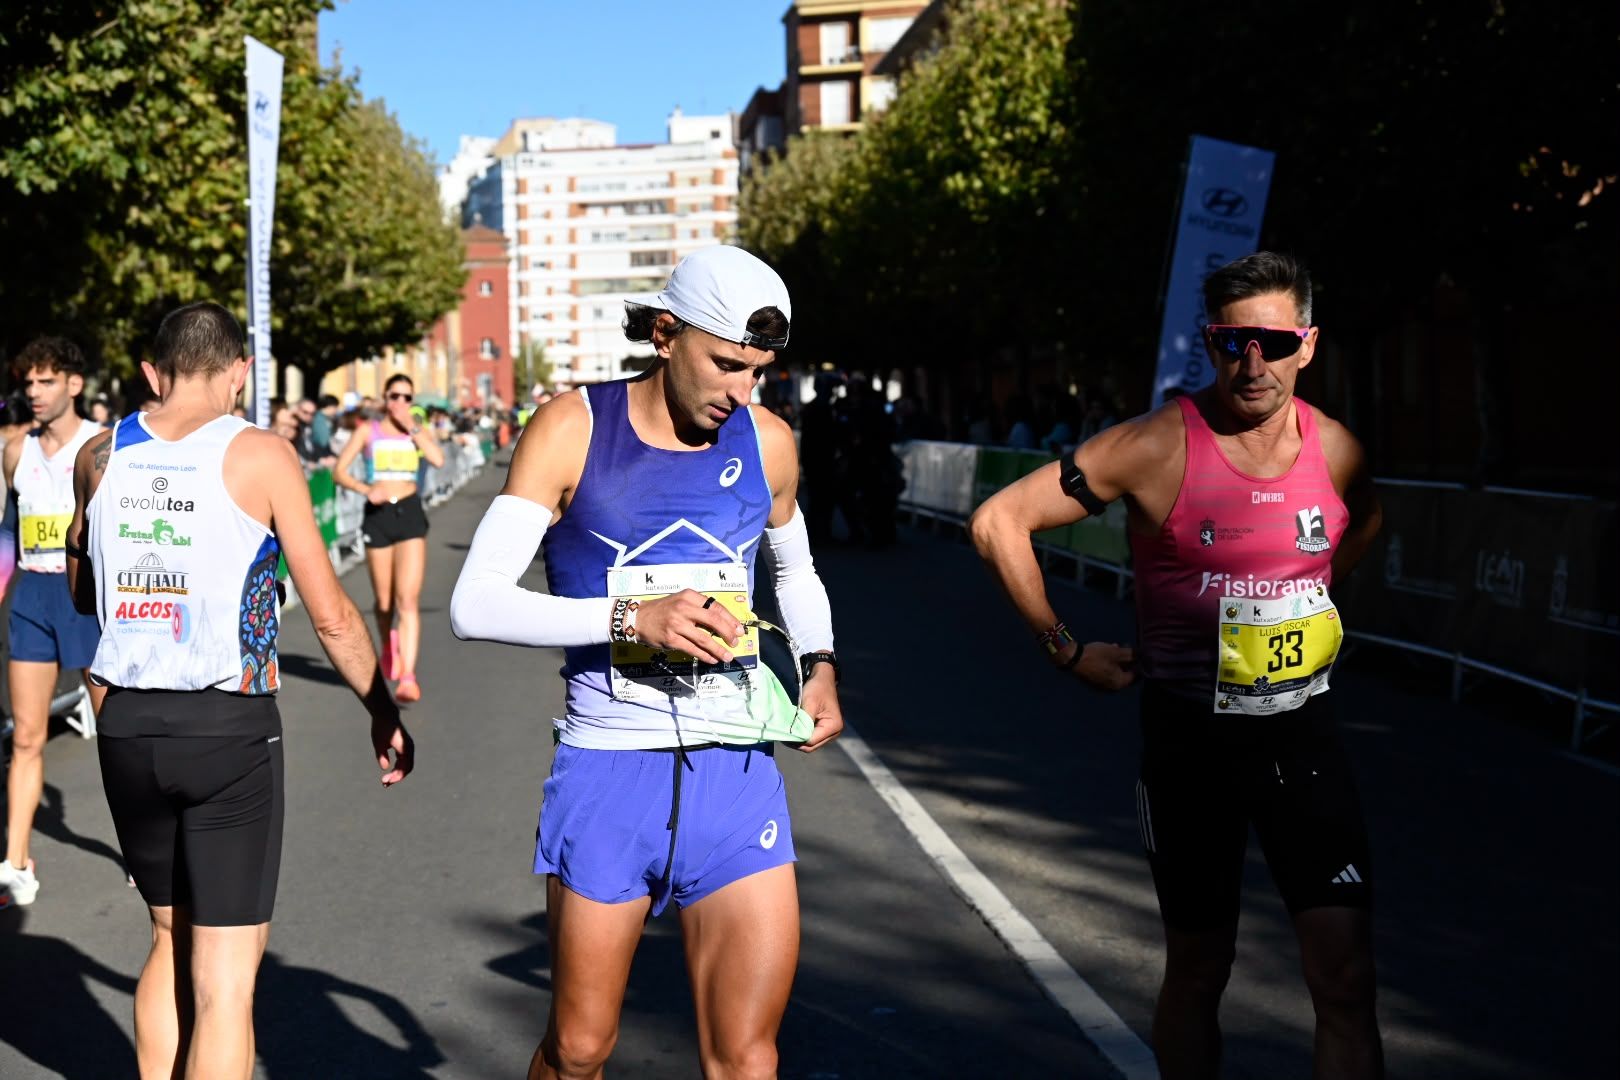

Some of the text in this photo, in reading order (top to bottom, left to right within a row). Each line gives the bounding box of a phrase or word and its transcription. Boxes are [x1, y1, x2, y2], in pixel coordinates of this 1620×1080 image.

[146, 463, 179, 472] Atletismo
[120, 495, 195, 513] evolutea
[36, 520, 59, 542] 84
[118, 523, 154, 540] Frutas
[115, 601, 173, 619] ALCOS
[1253, 605, 1261, 617] k
[1259, 627, 1281, 637] LUIS
[1267, 630, 1304, 674] 33
